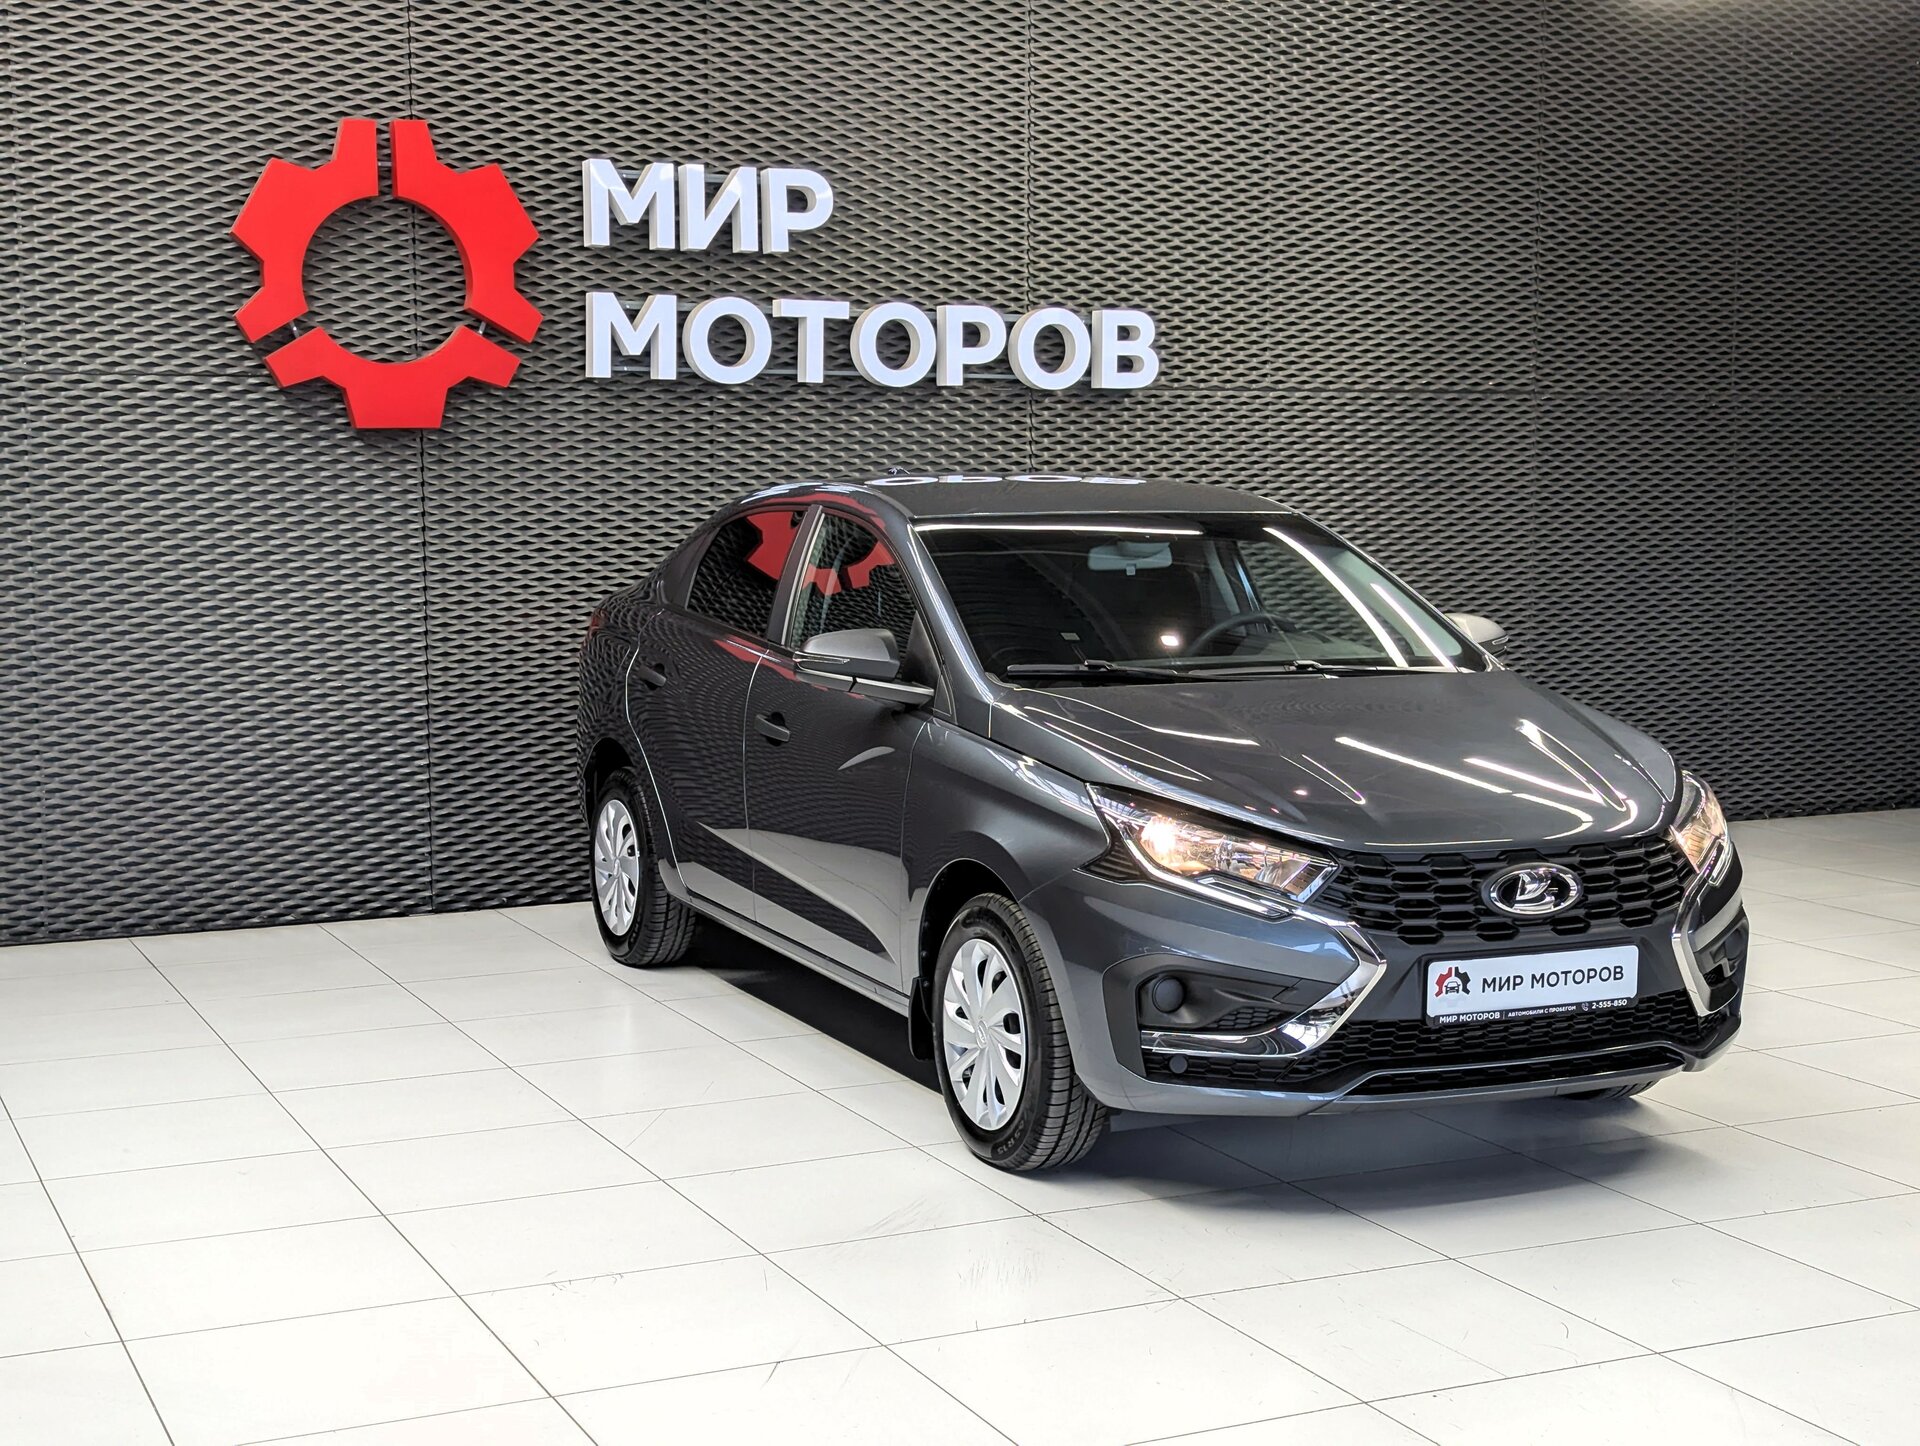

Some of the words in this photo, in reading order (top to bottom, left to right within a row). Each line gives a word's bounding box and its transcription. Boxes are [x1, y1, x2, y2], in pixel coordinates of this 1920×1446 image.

[582, 157, 834, 253] МИР
[585, 291, 1160, 390] МОТОРОВ
[1481, 975, 1524, 993] МИР
[1530, 965, 1624, 989] МОТОРОВ
[1439, 1015, 1458, 1024] МИР
[1459, 1011, 1501, 1022] МОТОРОВ
[1507, 1008, 1544, 1018] АВТОМОБИЛИ
[1548, 1004, 1577, 1013] ПРОБЕГОМ
[1591, 998, 1628, 1009] 2-555-850
